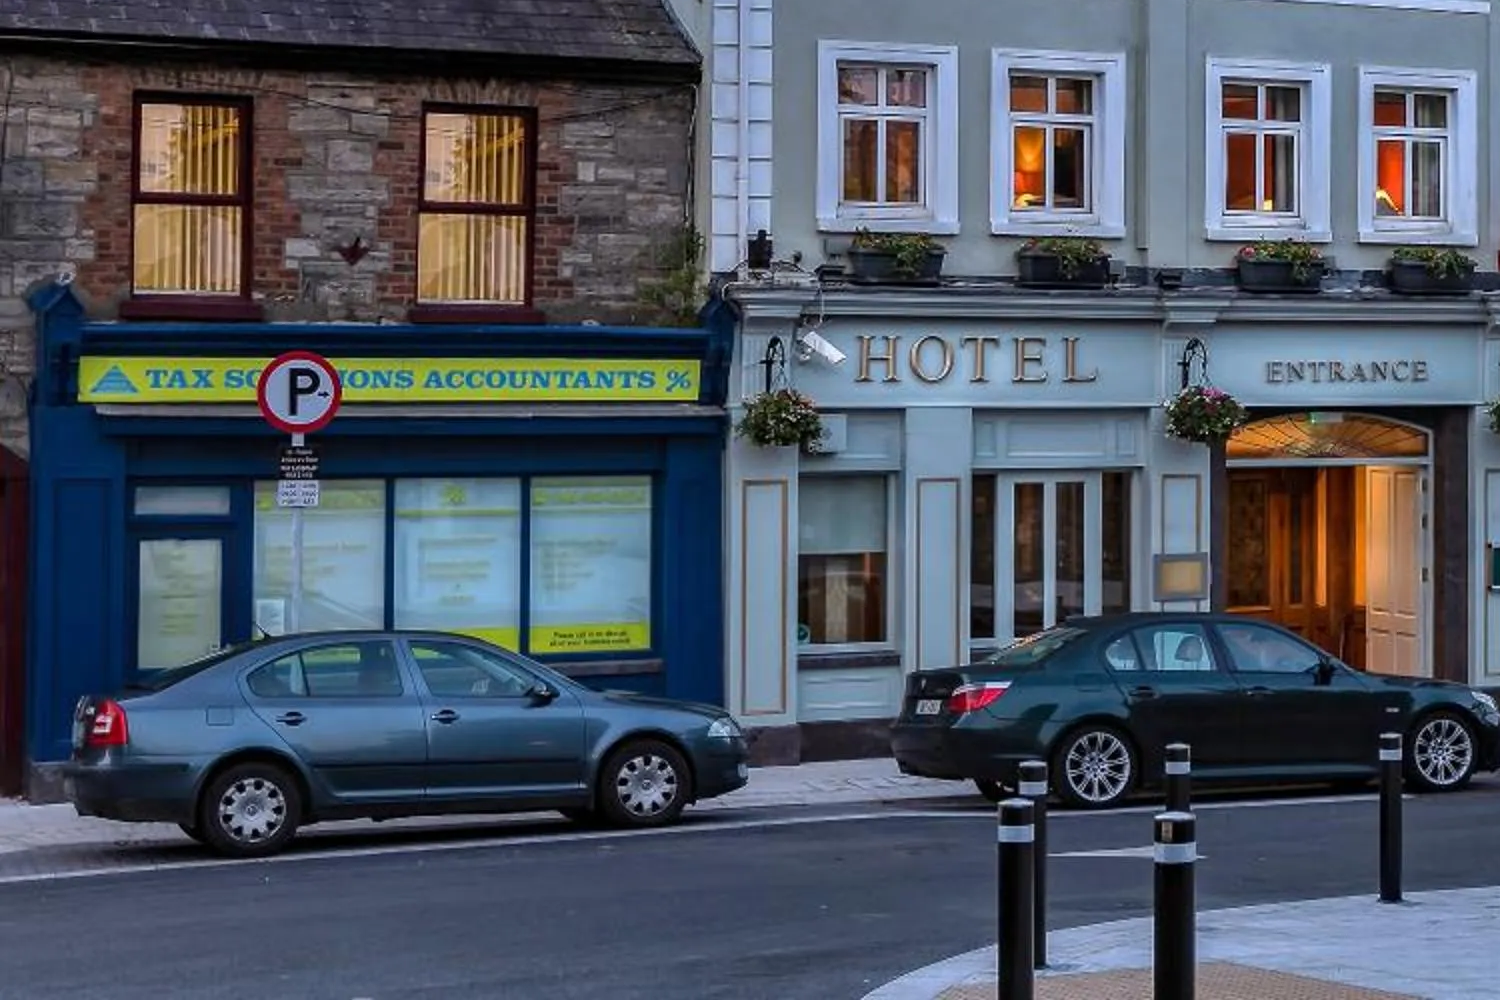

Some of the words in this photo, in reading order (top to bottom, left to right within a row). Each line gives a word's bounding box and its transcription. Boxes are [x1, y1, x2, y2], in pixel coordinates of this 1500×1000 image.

[853, 335, 1098, 384] HOTEL
[1265, 360, 1431, 384] ENTRANCE
[145, 369, 214, 389] TAX
[224, 368, 414, 389] SOIONS
[423, 369, 656, 390] ACCOUNTANTS
[288, 367, 321, 417] P
